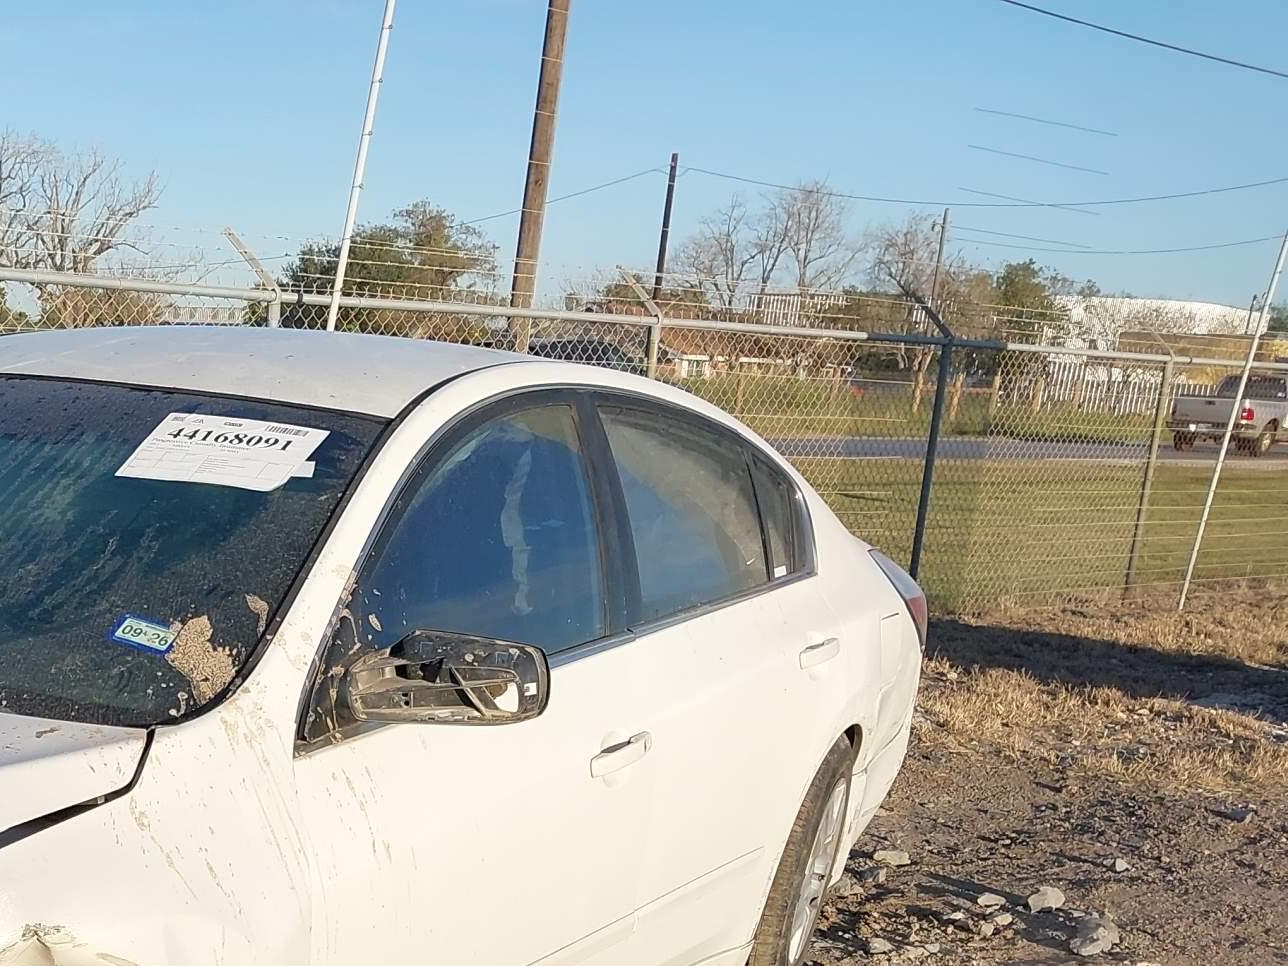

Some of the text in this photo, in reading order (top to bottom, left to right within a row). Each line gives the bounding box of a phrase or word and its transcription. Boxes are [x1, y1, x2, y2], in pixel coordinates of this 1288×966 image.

[167, 427, 294, 452] 44168091
[121, 624, 143, 637] 09
[152, 632, 169, 646] 26
